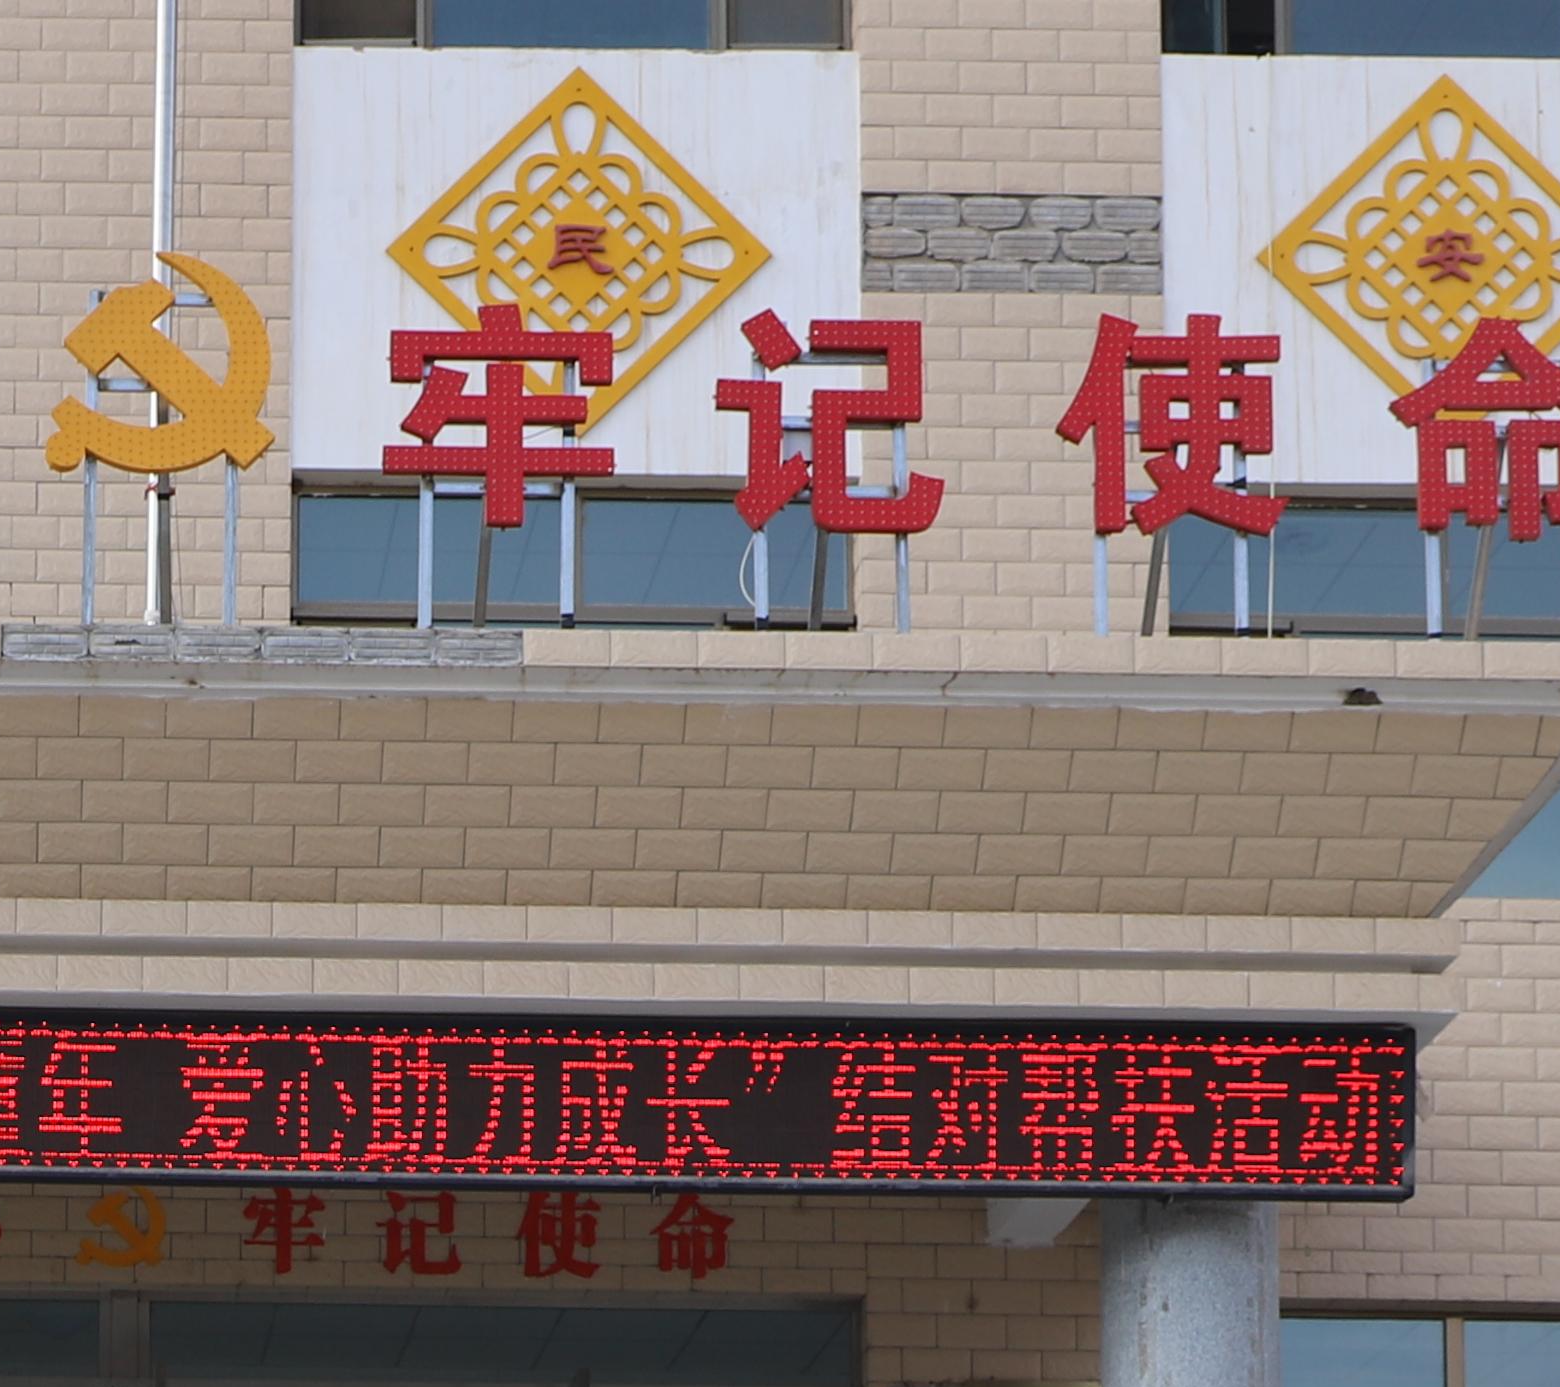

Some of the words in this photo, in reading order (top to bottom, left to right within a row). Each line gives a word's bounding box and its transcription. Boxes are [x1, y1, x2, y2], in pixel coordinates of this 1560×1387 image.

[546, 222, 615, 277] 民
[1417, 229, 1484, 284] 安
[832, 1051, 1380, 1173] 结对帮扶活动
[242, 1192, 736, 1280] 牢记使命
